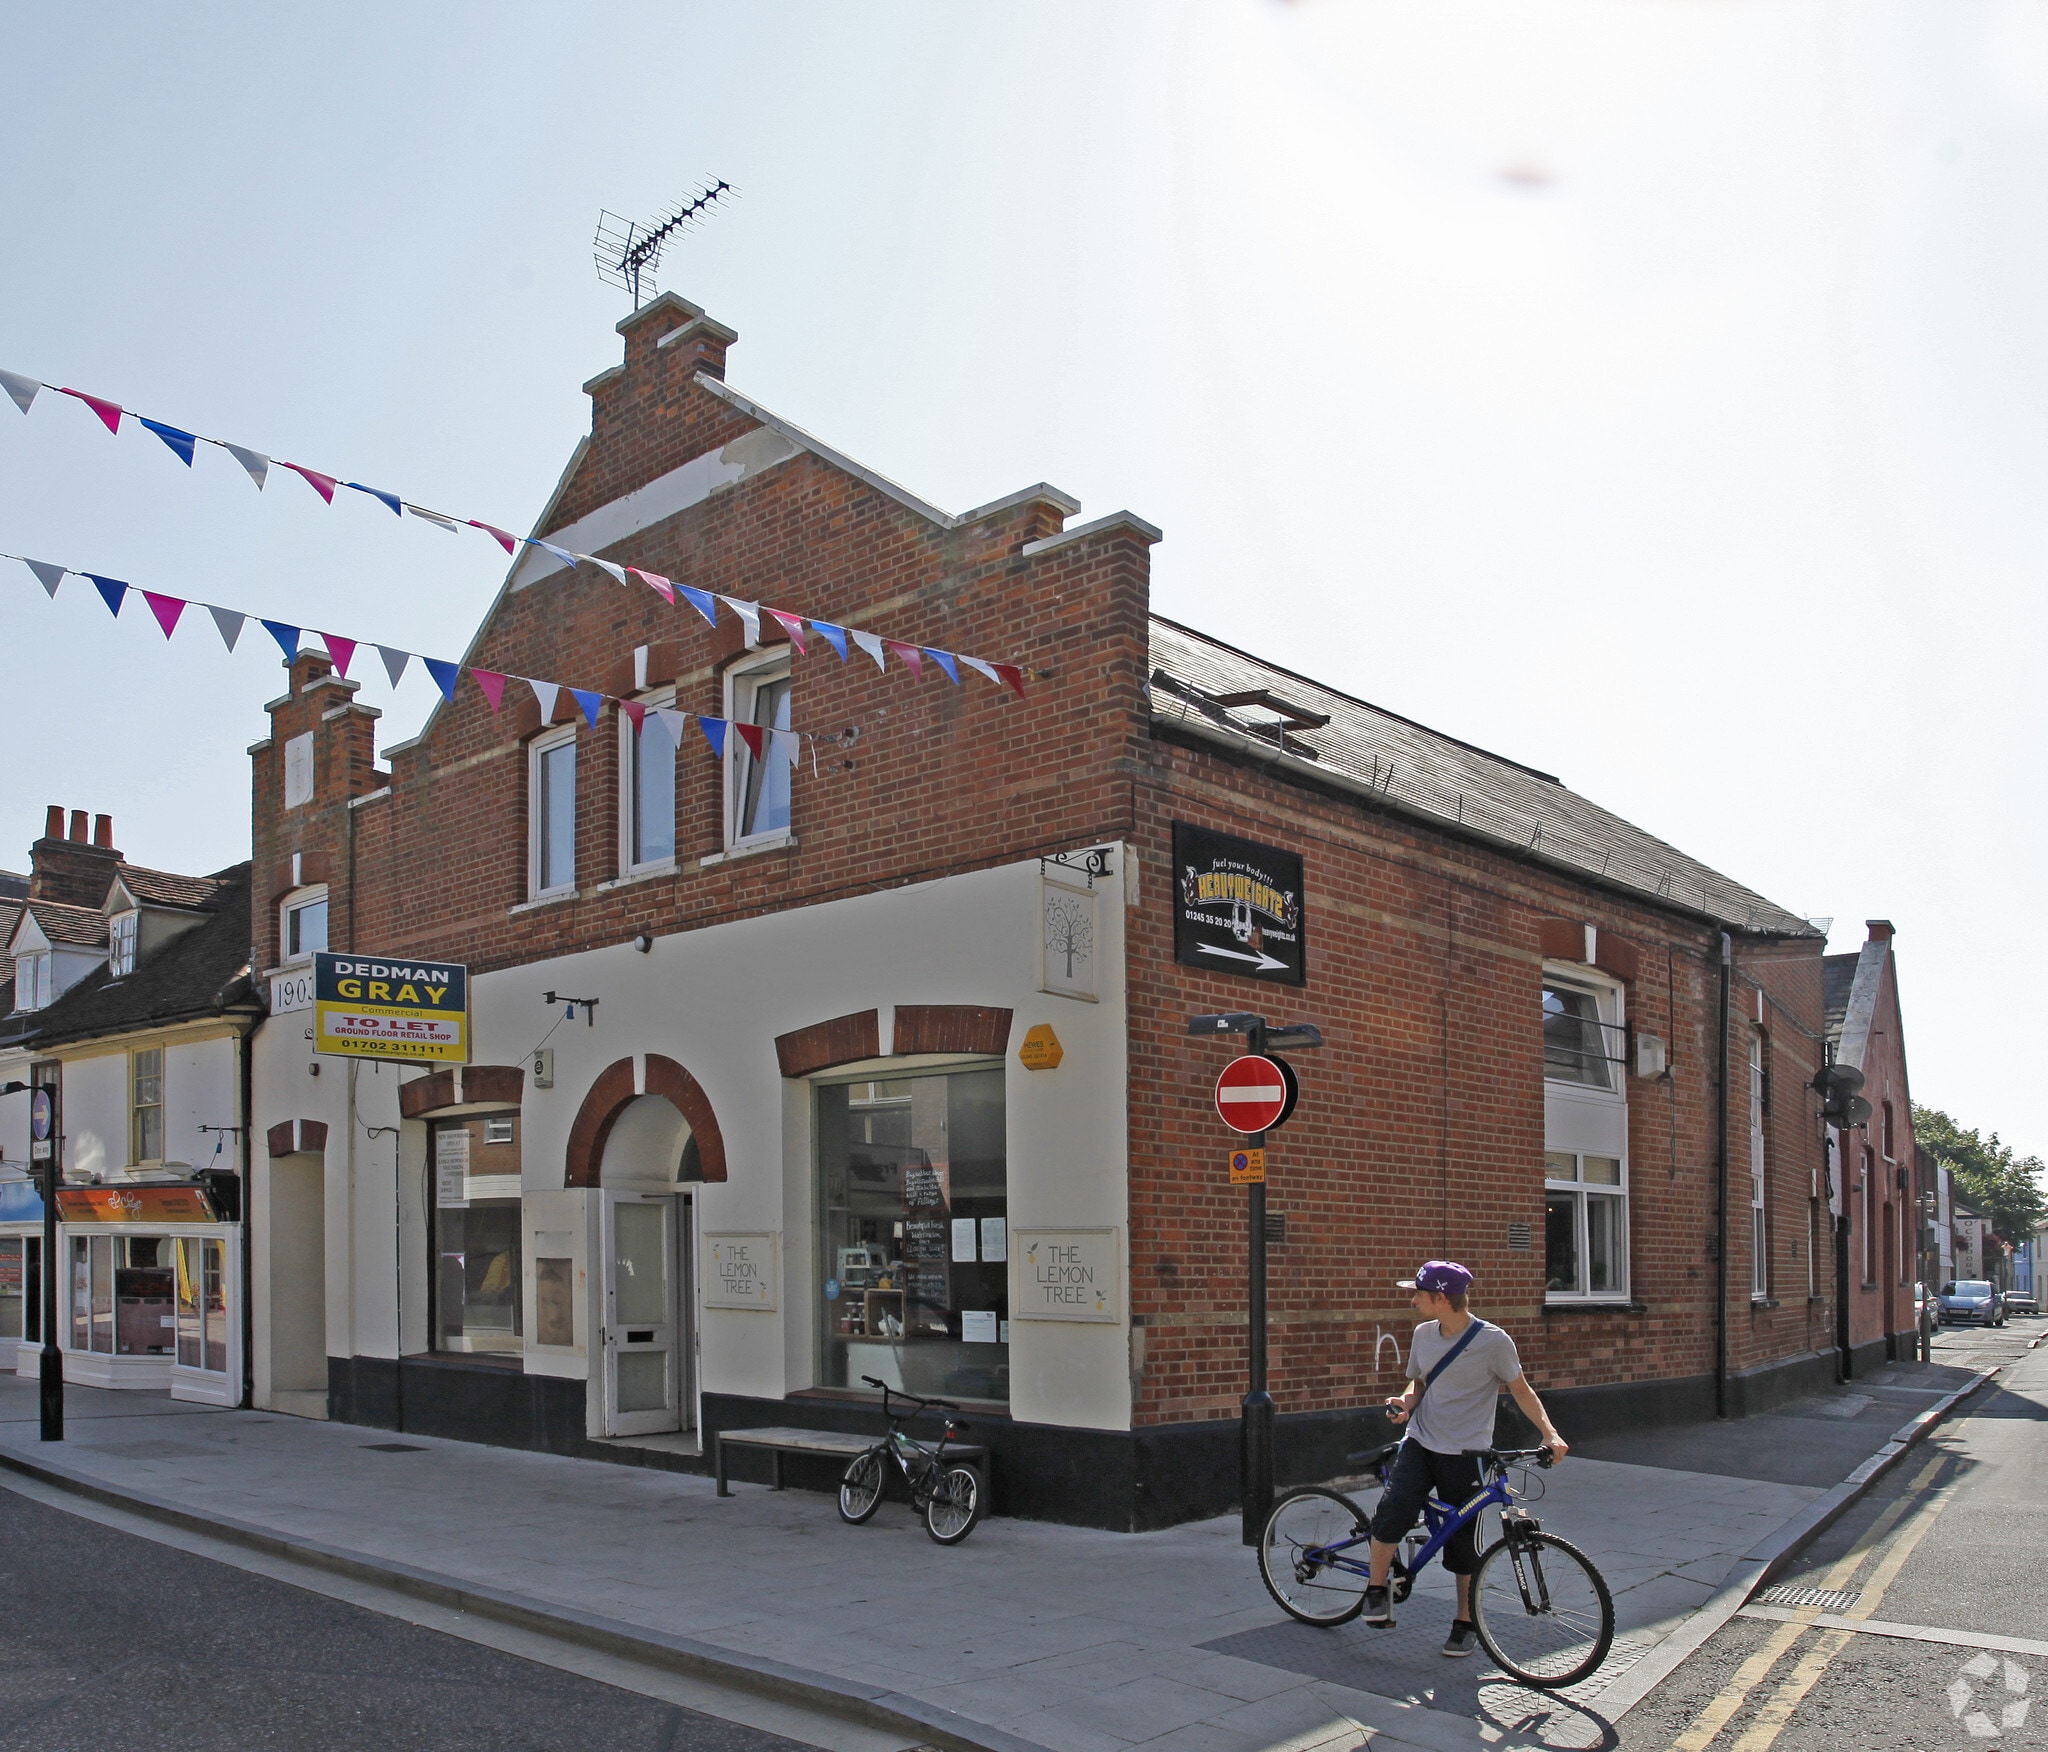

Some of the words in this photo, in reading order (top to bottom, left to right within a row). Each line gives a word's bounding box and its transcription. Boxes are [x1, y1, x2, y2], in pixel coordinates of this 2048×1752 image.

[1212, 858, 1227, 871] fuel
[1227, 861, 1245, 871] your
[1185, 910, 1205, 923] 01245
[1205, 914, 1214, 924] 35
[1215, 916, 1223, 926] 20
[1223, 919, 1232, 929] 20
[335, 961, 449, 983] DEDMAN
[337, 979, 447, 1005] GRAY
[361, 1006, 423, 1017] Commercial
[343, 1017, 379, 1028] TO
[390, 1020, 439, 1031] LET
[335, 1026, 370, 1036] GROUND
[372, 1029, 398, 1038] FLOOR
[400, 1031, 427, 1040] RETAIL
[429, 1033, 452, 1041] SHOP
[342, 1040, 387, 1050] 01702
[392, 1043, 443, 1054] 311111
[727, 1246, 750, 1261] THE
[1048, 1246, 1081, 1263] THE
[720, 1262, 757, 1278] LEMON
[1037, 1266, 1093, 1283] LEMON
[724, 1279, 753, 1295] TREE
[1043, 1286, 1087, 1304] TREE
[1458, 1490, 1490, 1517] PROFESSIONAL
